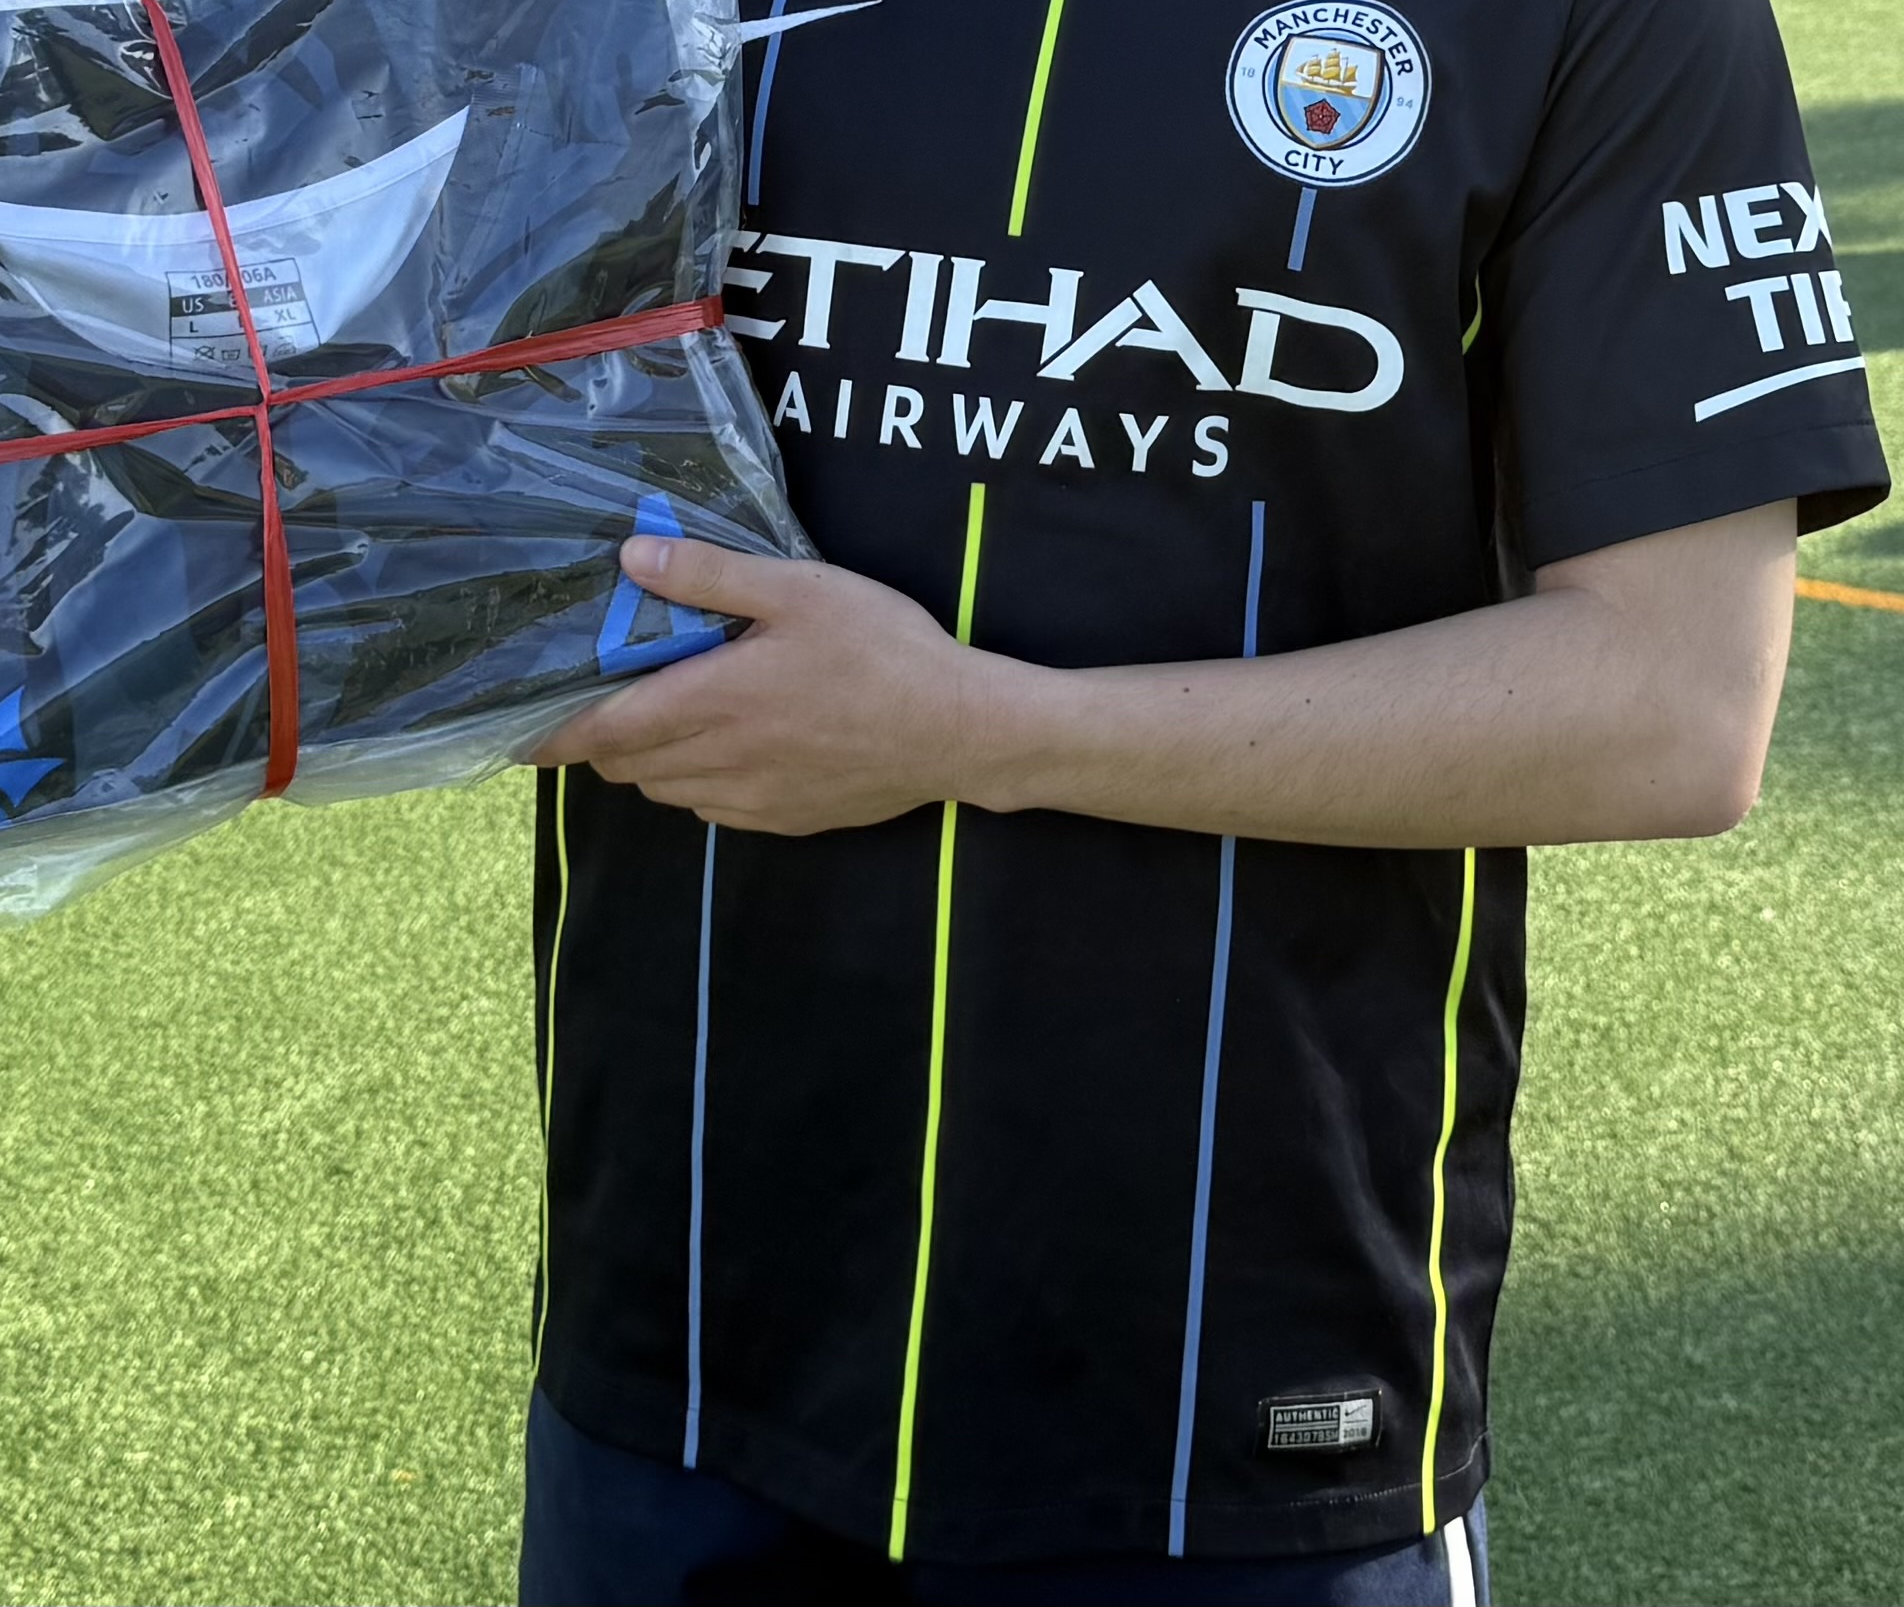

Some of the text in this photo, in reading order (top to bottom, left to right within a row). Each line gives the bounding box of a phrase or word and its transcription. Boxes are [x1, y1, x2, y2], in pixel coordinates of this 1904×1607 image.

[1254, 7, 1414, 76] MANCHESTER
[1240, 66, 1414, 110] 18 94
[1285, 149, 1344, 176] CITY
[182, 297, 205, 314] US
[263, 286, 298, 303] ASIA
[189, 308, 297, 334] L XL
[722, 230, 1405, 413] ETIHAD
[774, 370, 1231, 477] AIRWAYS
[1276, 1407, 1339, 1423] AUTHENTIC
